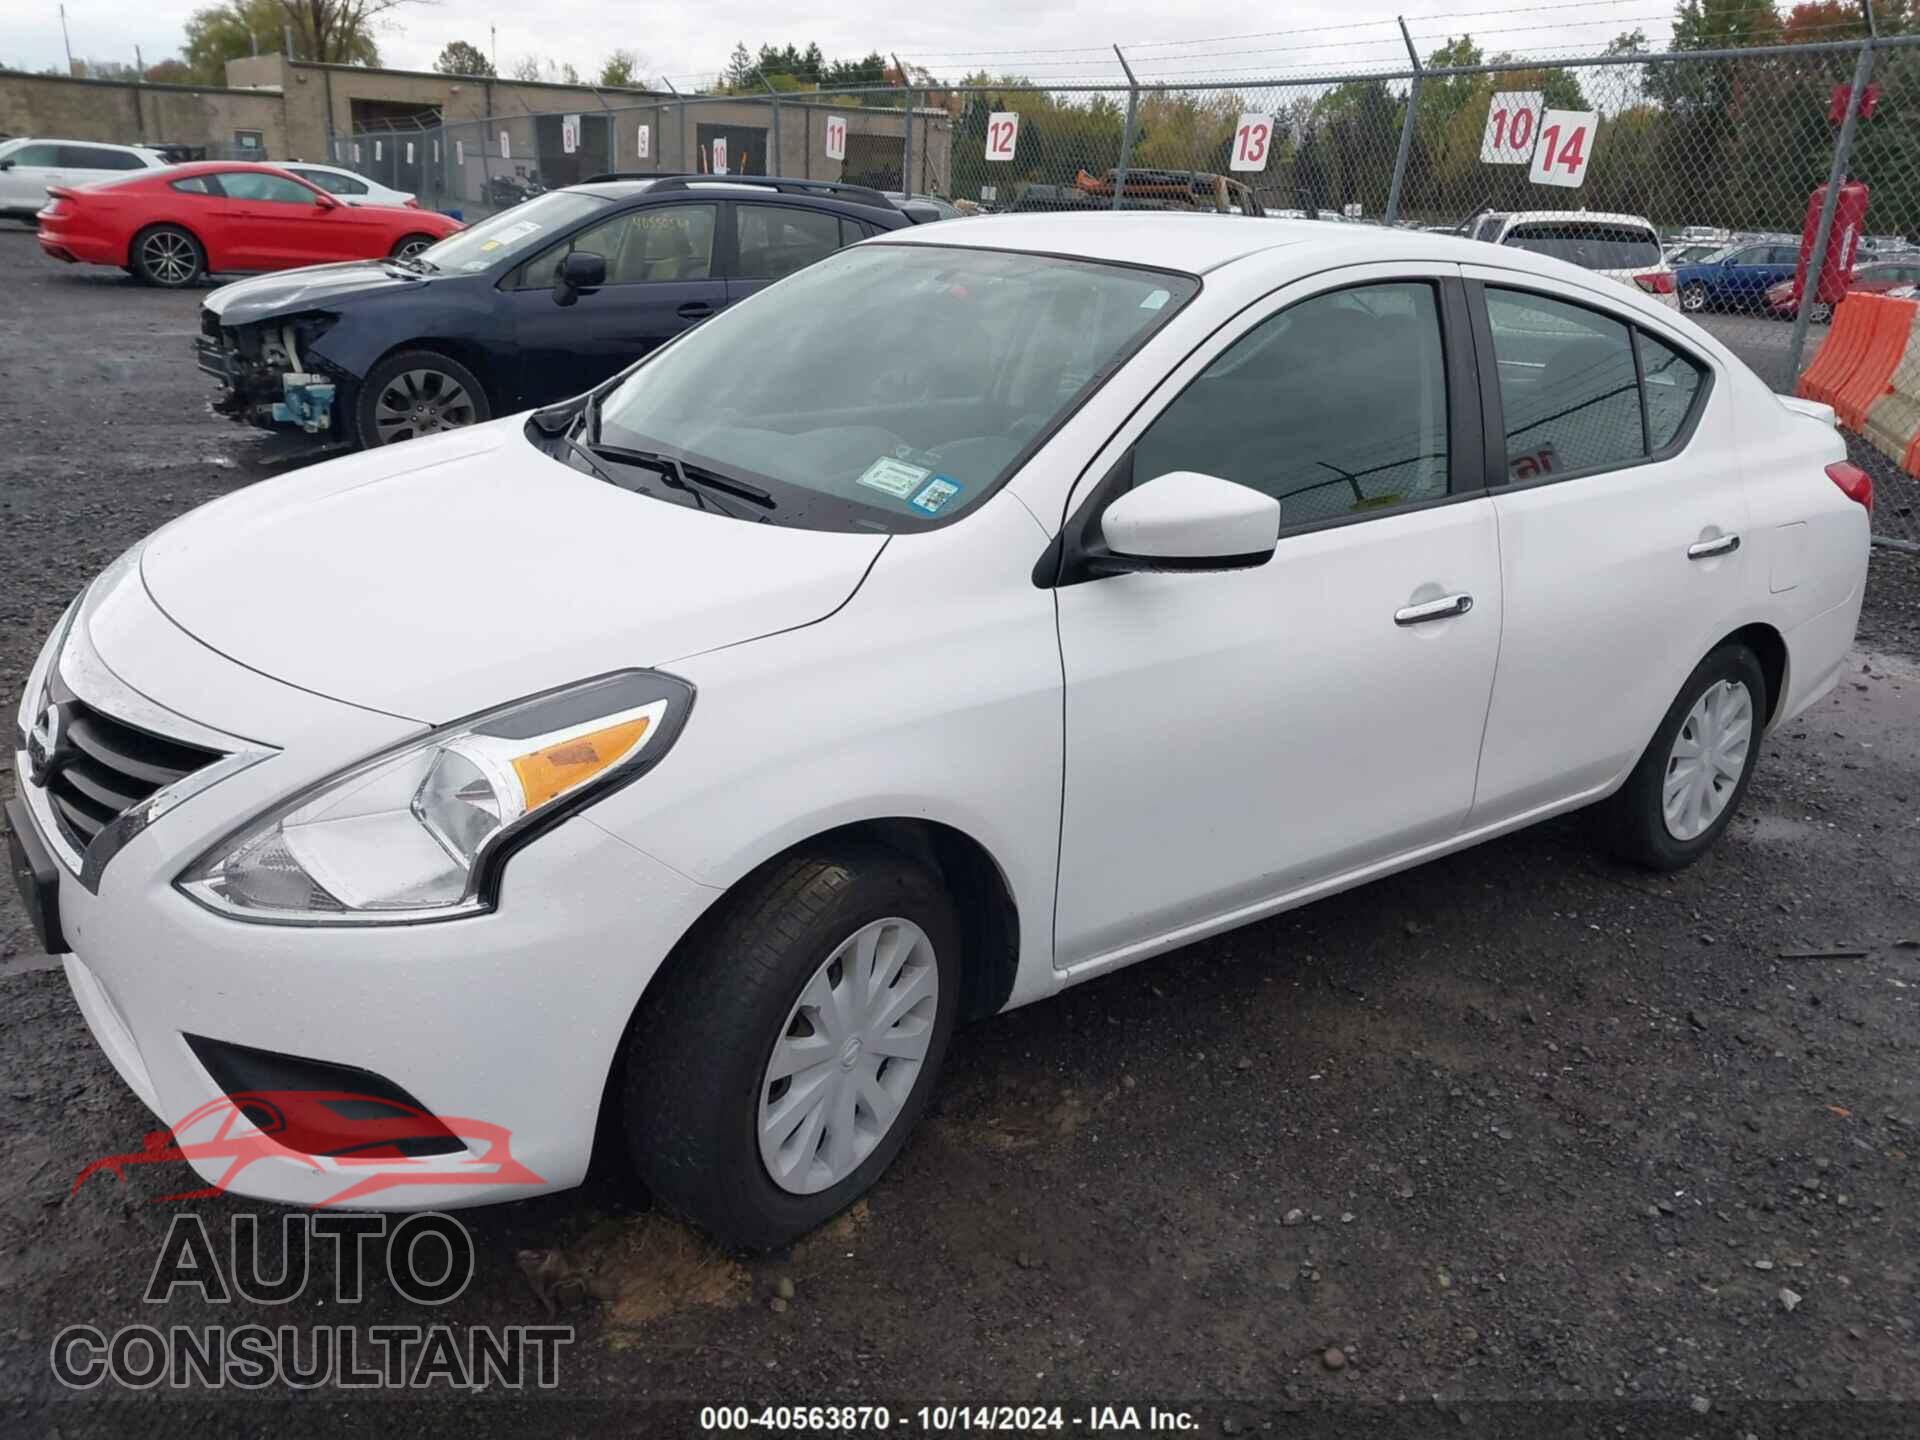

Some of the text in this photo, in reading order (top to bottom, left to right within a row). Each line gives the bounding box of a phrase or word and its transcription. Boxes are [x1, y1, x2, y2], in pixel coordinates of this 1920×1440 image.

[828, 125, 844, 150] 11
[989, 122, 1015, 153] 12
[1238, 124, 1268, 162] 13
[1491, 107, 1534, 150] 10
[714, 145, 726, 168] 10
[1541, 124, 1586, 174] 14
